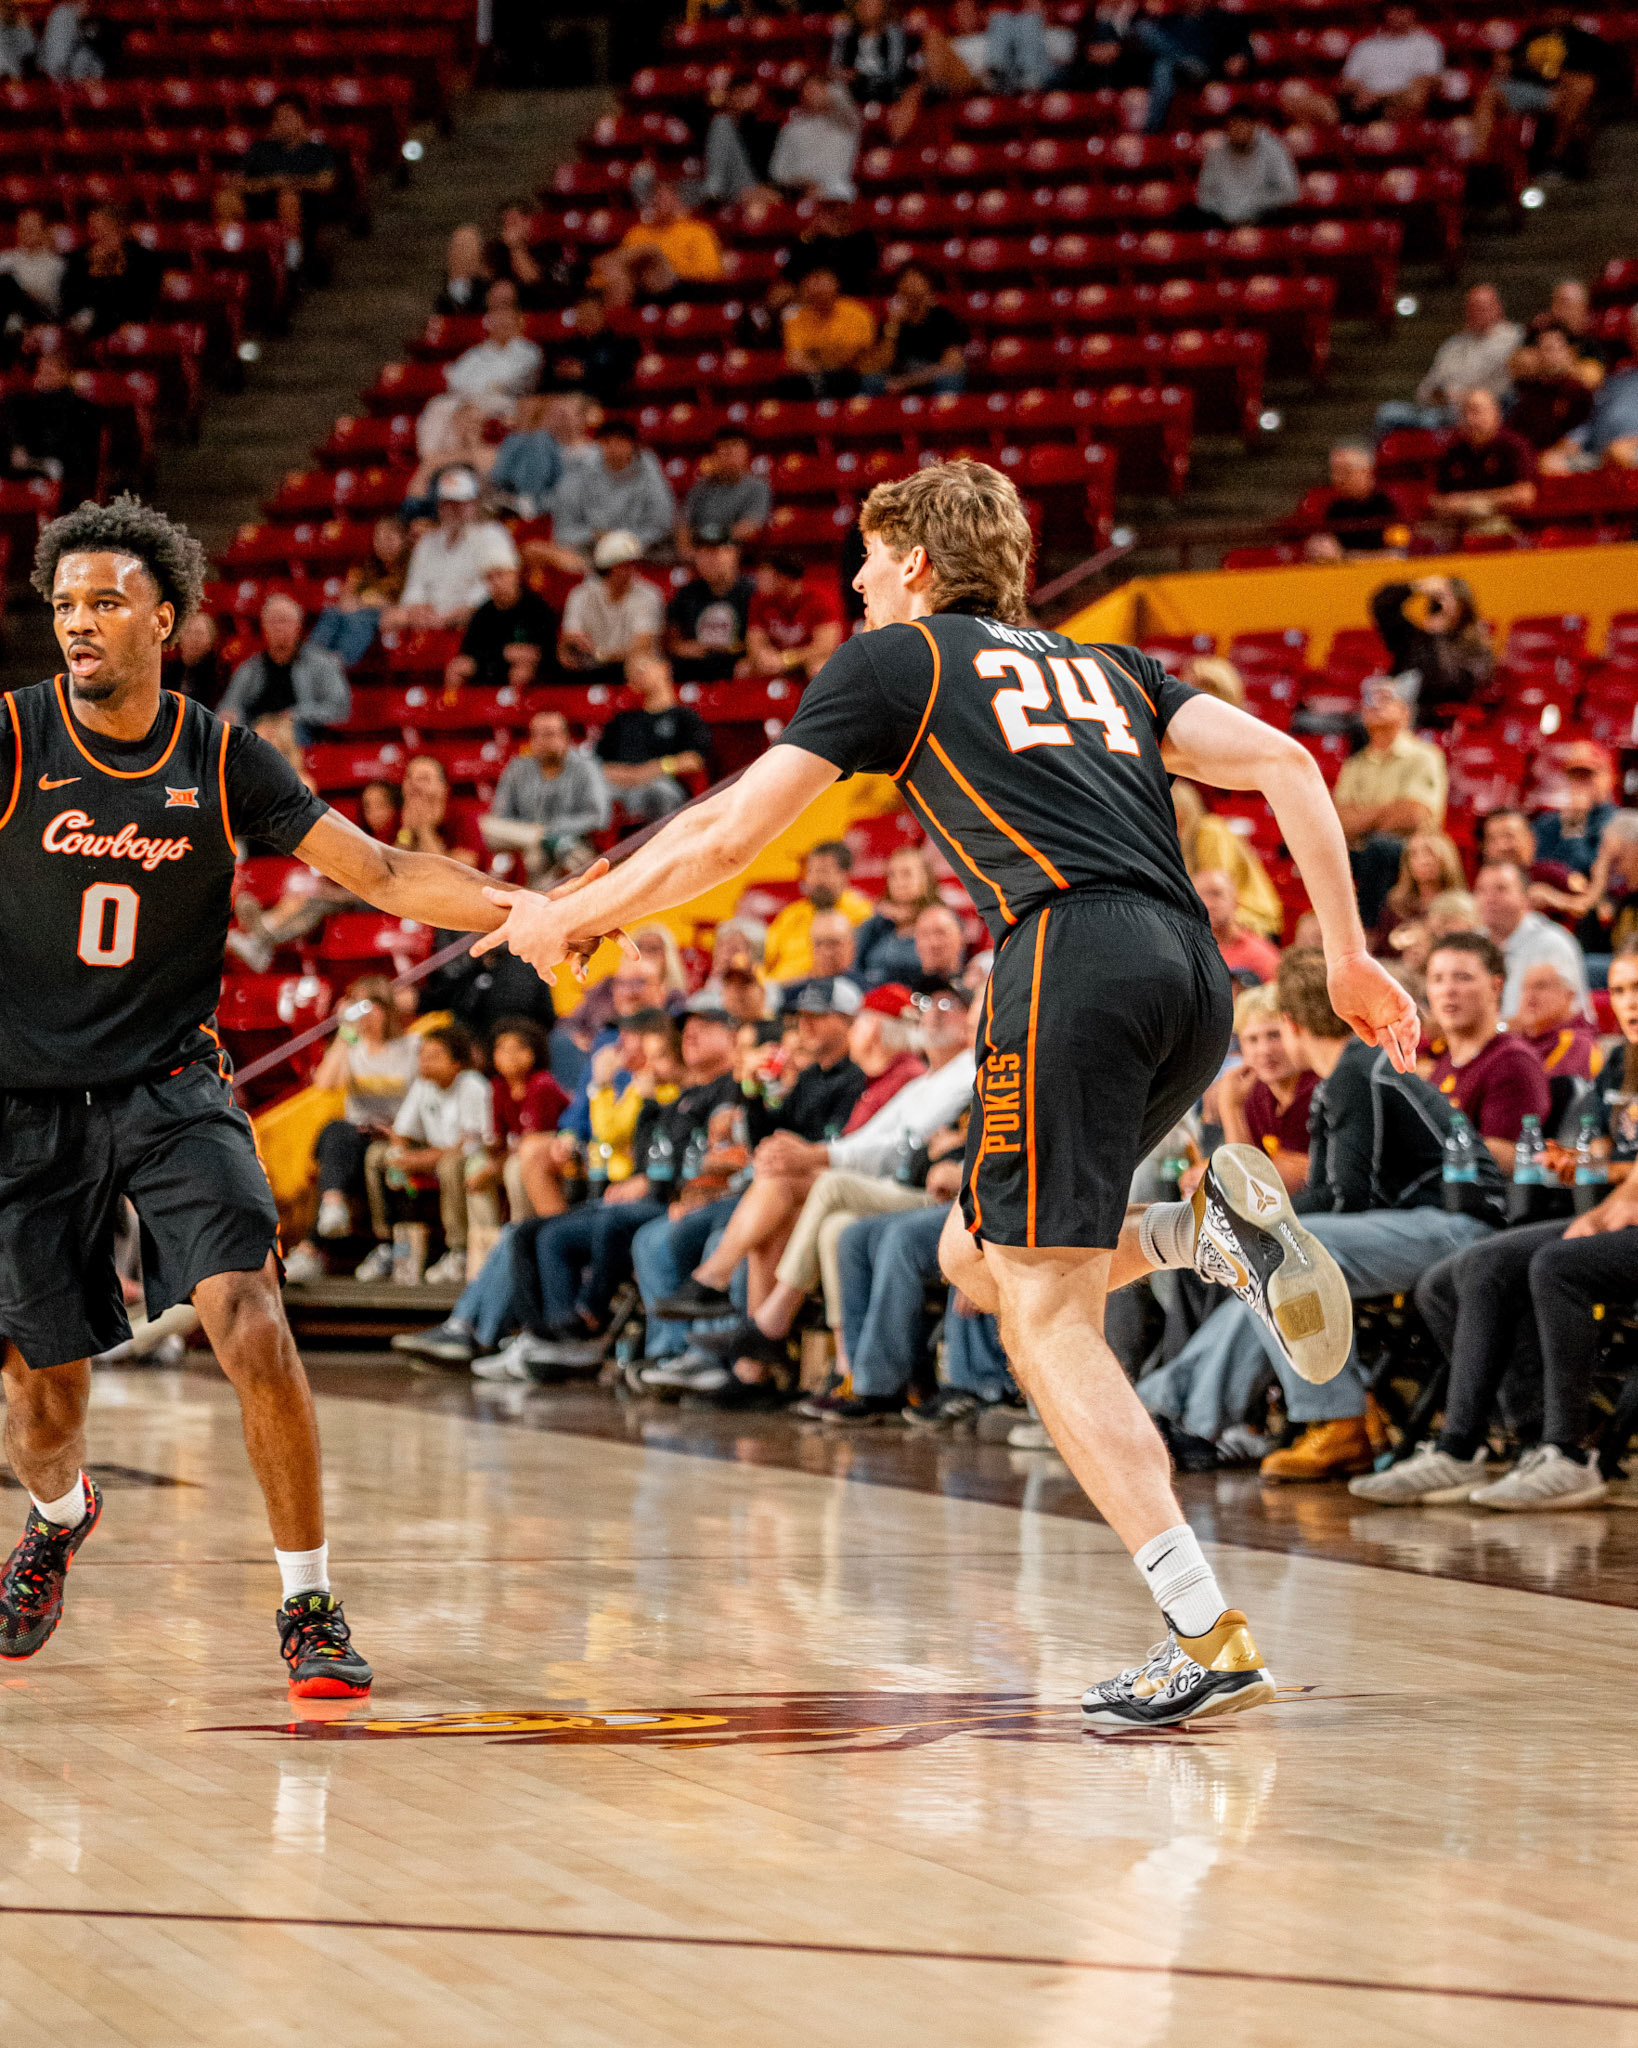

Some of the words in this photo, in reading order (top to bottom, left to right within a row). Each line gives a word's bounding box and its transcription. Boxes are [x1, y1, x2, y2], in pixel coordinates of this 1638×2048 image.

[972, 648, 1141, 757] 24
[42, 809, 193, 871] Cowboys
[77, 881, 140, 968] 0
[984, 1052, 1021, 1154] POKES
